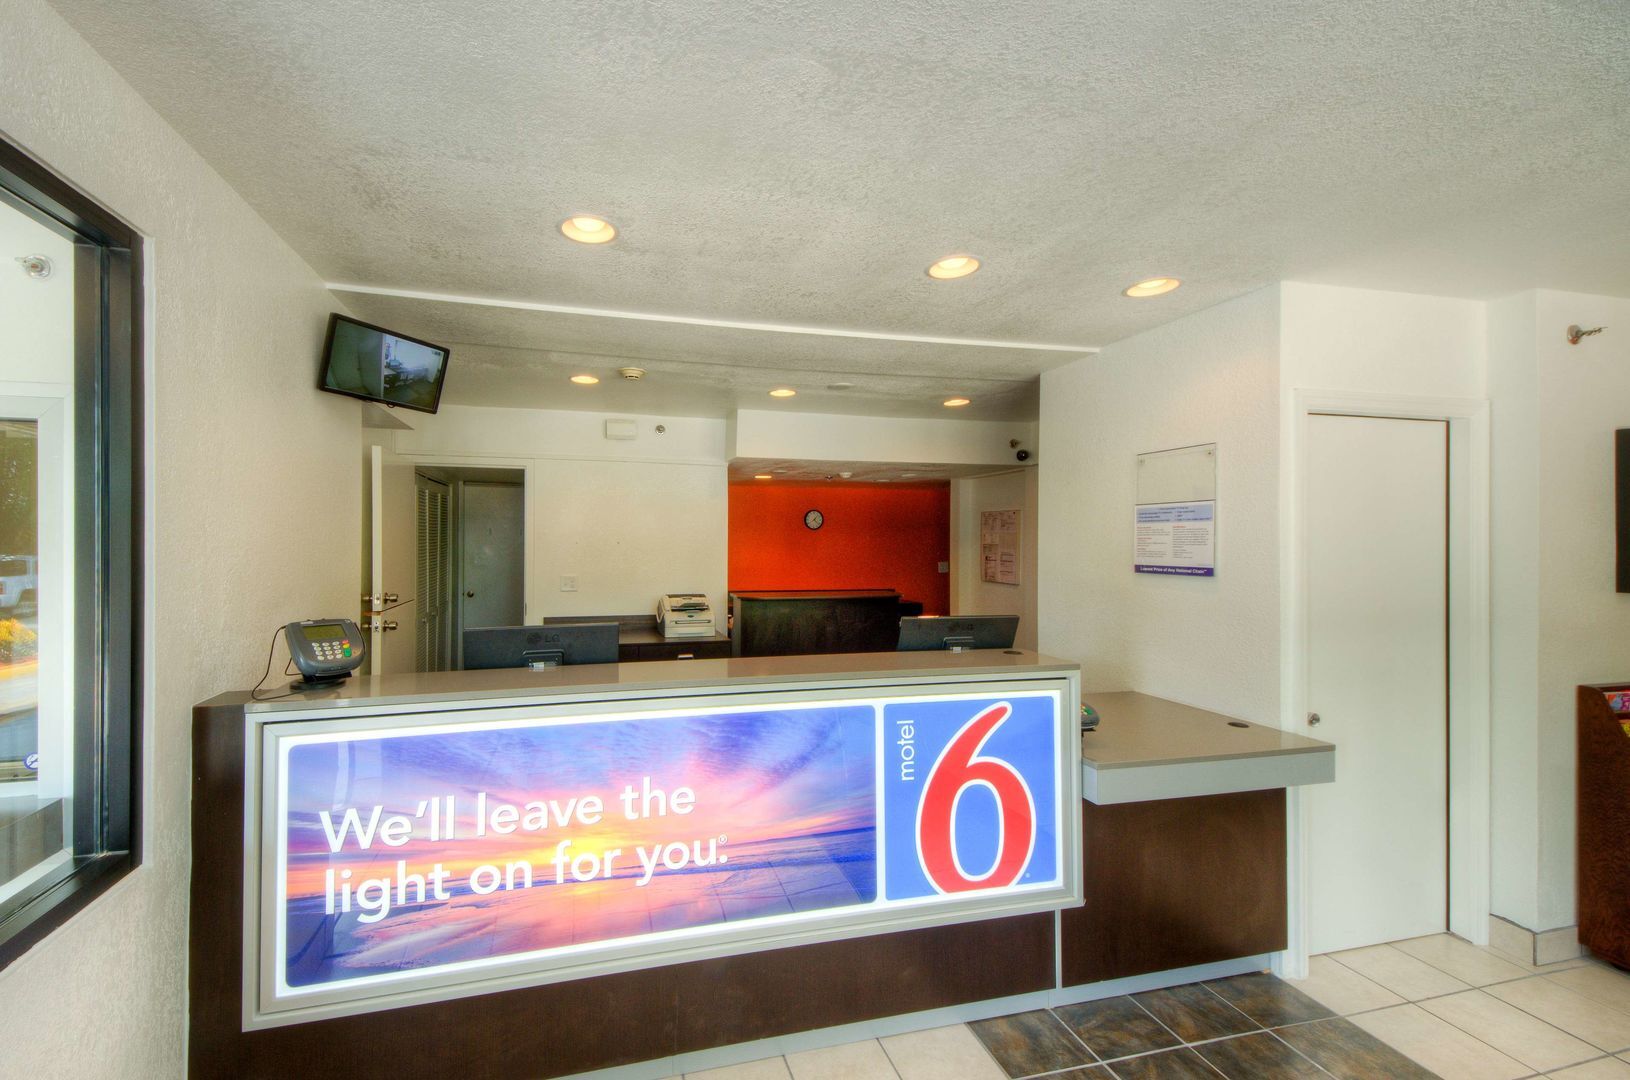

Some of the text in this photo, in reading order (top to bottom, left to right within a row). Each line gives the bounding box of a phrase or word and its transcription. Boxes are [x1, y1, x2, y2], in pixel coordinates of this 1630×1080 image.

[897, 719, 915, 781] motel
[477, 792, 604, 836] leave
[620, 776, 696, 821] the
[915, 701, 1036, 895] 6
[325, 860, 451, 923] light
[469, 860, 533, 895] on
[551, 840, 622, 884] for
